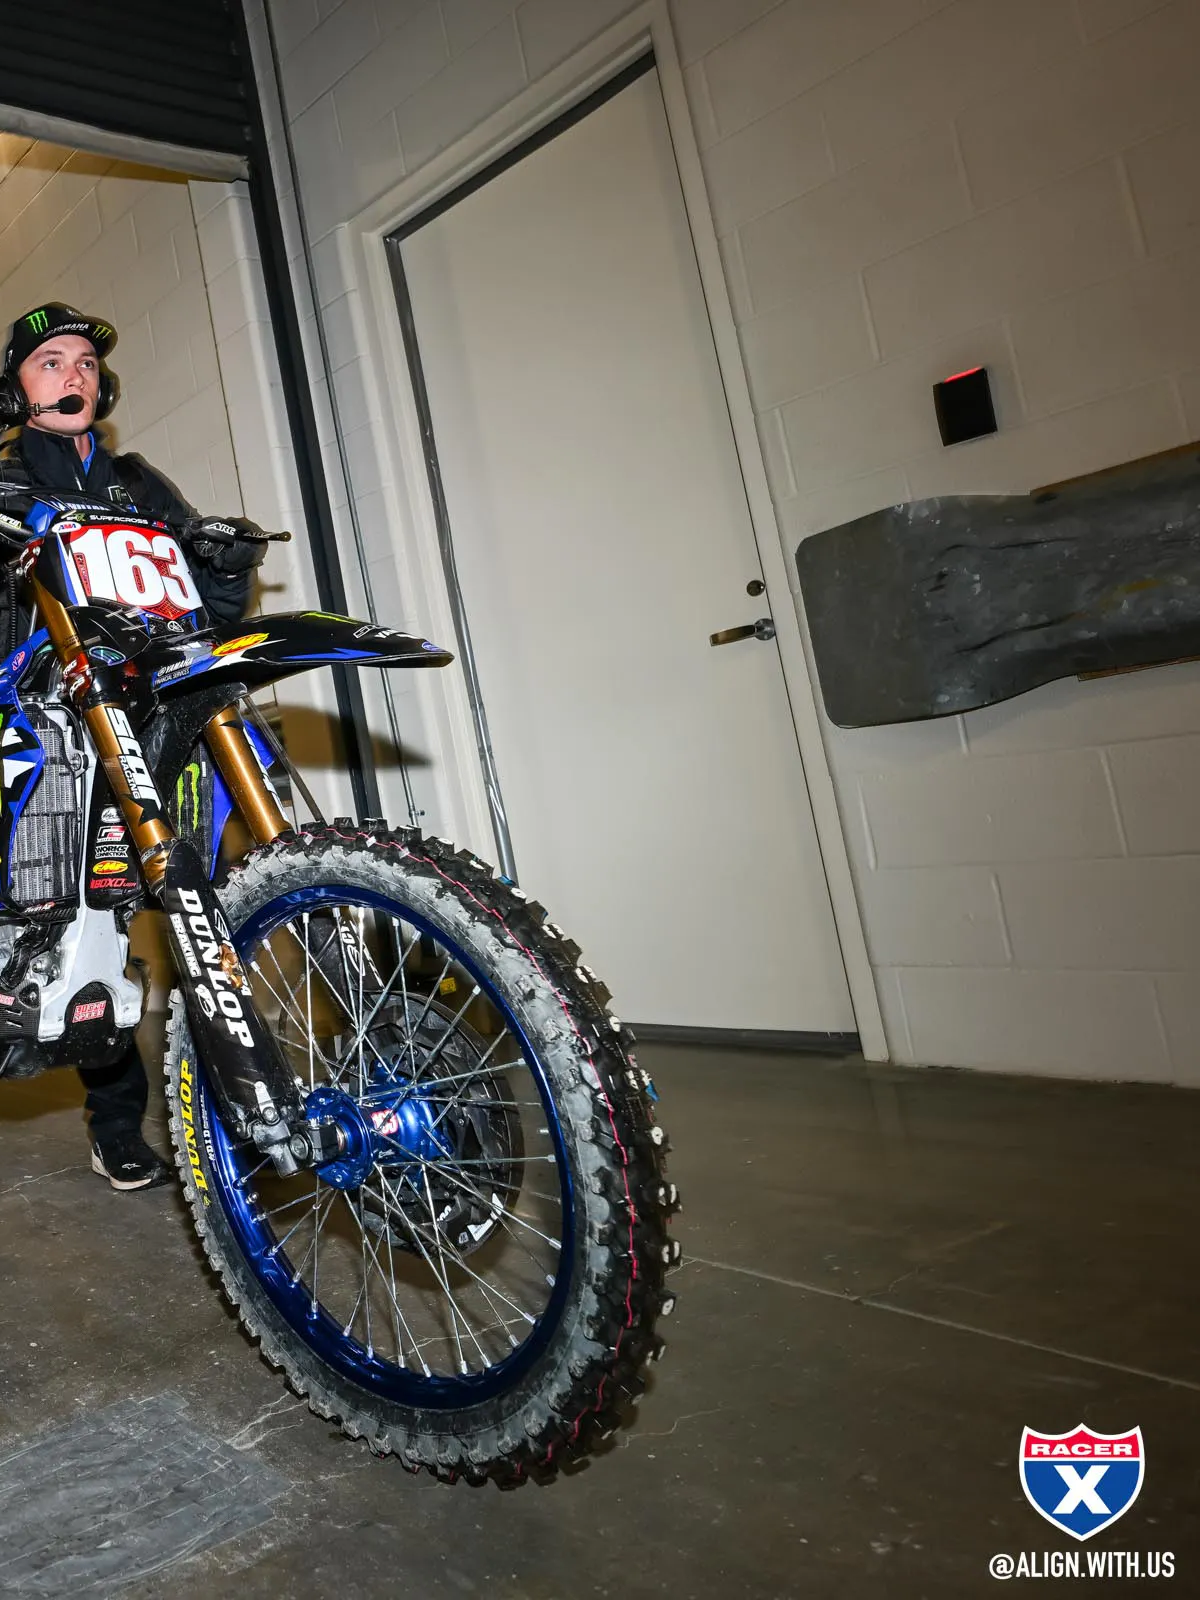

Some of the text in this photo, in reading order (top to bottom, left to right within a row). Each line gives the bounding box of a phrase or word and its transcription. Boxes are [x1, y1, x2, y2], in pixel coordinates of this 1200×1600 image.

[89, 514, 149, 525] SUPERCROSS
[204, 522, 237, 536] ARC
[69, 528, 203, 613] 163
[165, 657, 194, 674] YAMAHA
[118, 755, 141, 799] RACING
[170, 913, 202, 977] BRAKING
[177, 887, 255, 1048] DUNLOP
[180, 1059, 208, 1191] DUNLOP
